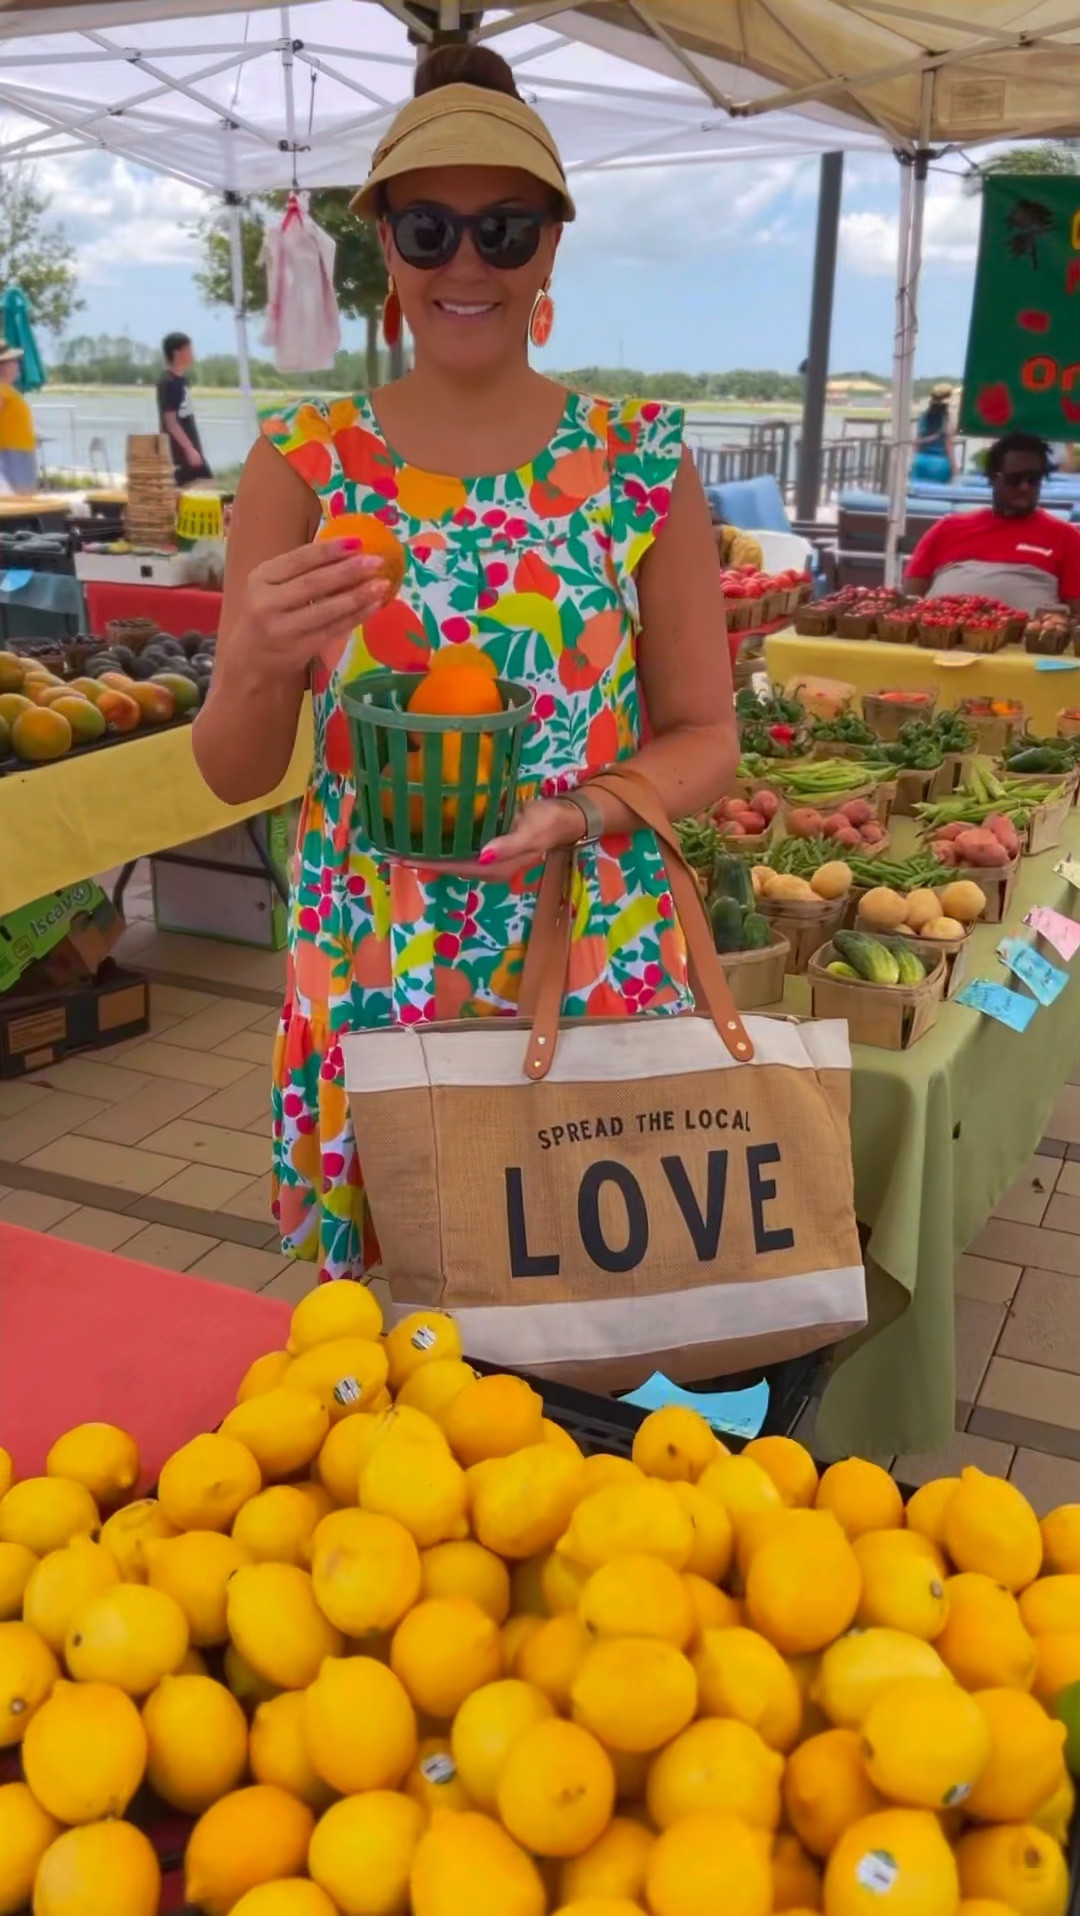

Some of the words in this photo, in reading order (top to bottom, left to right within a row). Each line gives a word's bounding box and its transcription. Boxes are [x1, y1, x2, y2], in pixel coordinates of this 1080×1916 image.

[537, 1116, 624, 1150] SPREAD
[635, 1110, 675, 1133] THE
[685, 1108, 751, 1132] LOCAL
[504, 1142, 795, 1278] LOVE
